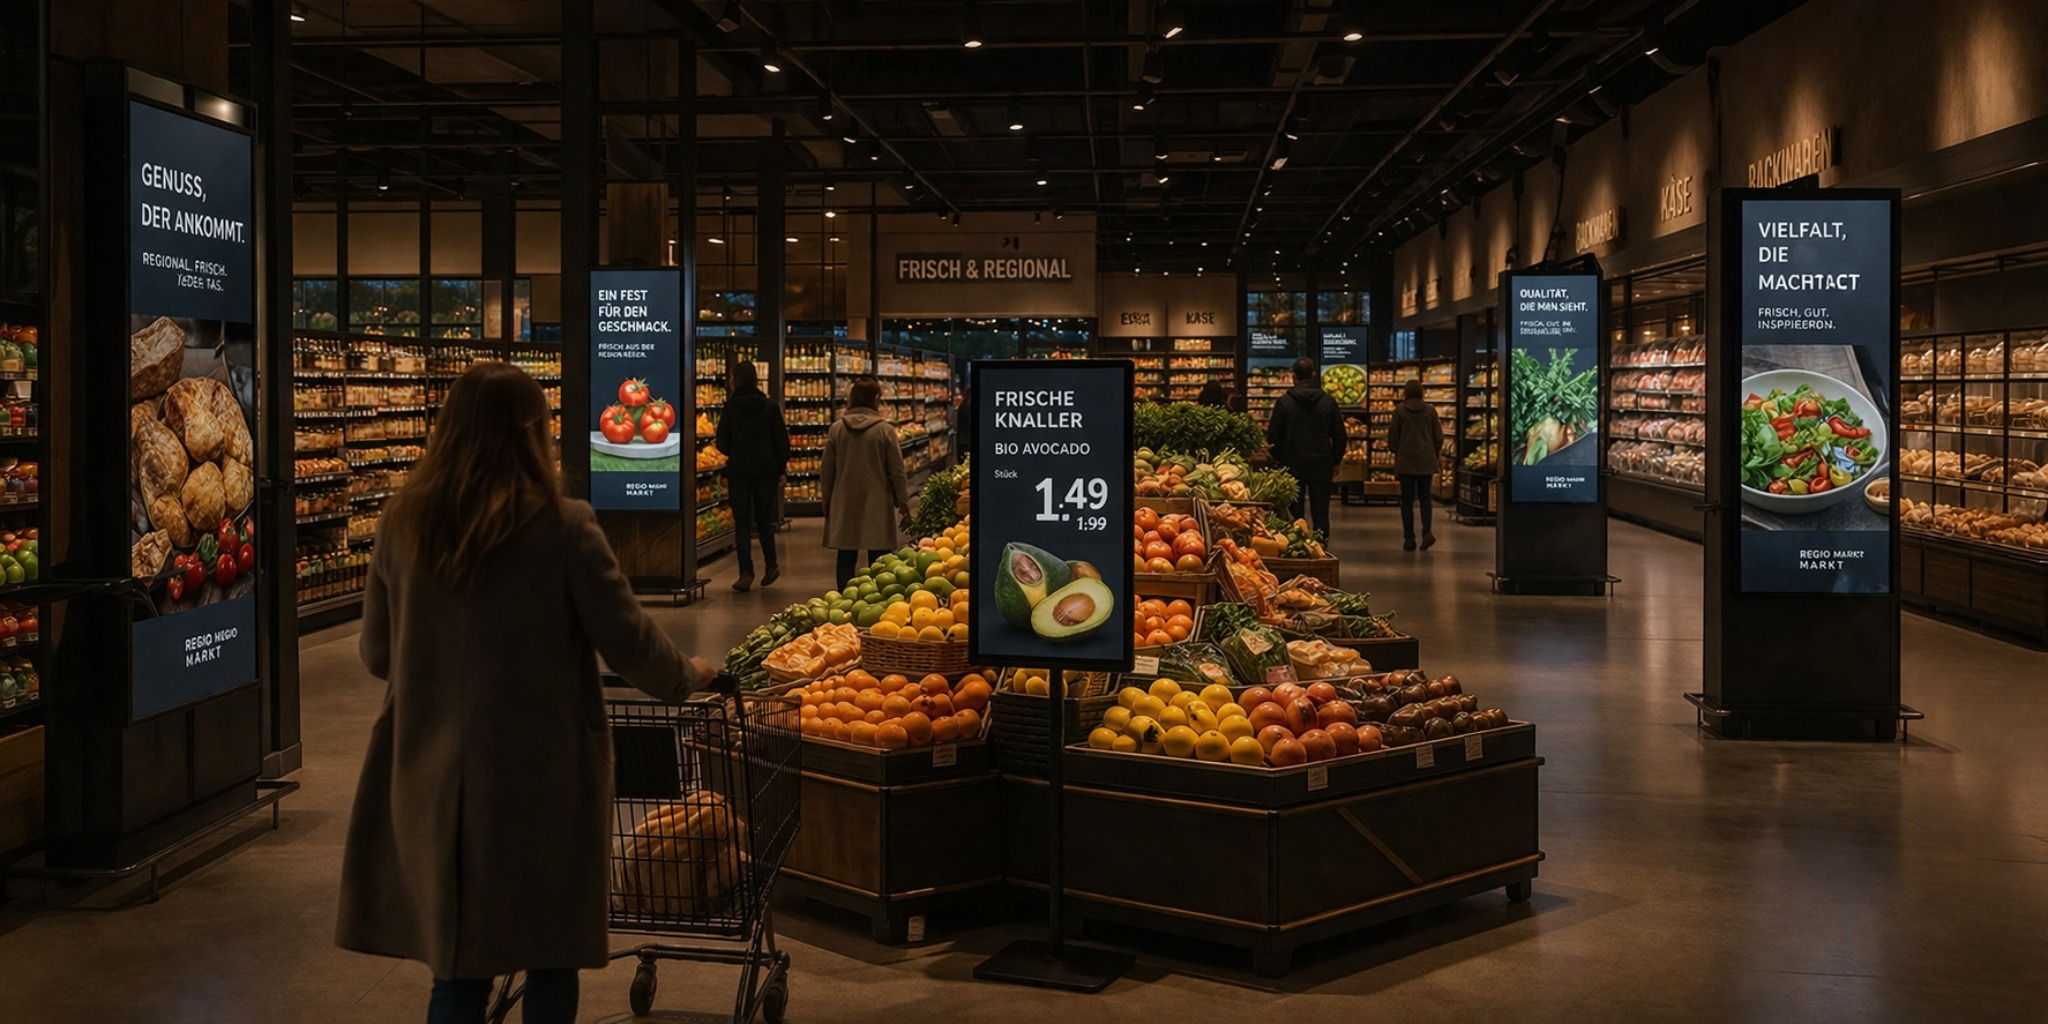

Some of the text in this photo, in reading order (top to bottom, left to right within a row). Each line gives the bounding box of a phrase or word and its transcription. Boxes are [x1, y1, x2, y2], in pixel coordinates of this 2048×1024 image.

[141, 163, 206, 202] GENUSS,
[142, 203, 245, 243] DER ANKOMMT.
[1759, 222, 1846, 240] VIELFALT,
[143, 252, 193, 271] REGIONAL.
[1759, 247, 1788, 262] DIE
[899, 257, 1072, 281] FRISCH & REGIONAL
[599, 290, 648, 300] EIN FEST
[599, 303, 647, 317] FÜR DEN
[1520, 302, 1535, 311] DIE
[1759, 308, 1829, 318] FRISCH, GUT.
[599, 321, 671, 332] GESCHMACK.
[996, 391, 1074, 406] FRISCHE
[996, 412, 1082, 428] KNALLER
[995, 443, 1090, 455] BIO AVOCADO
[995, 470, 1017, 478] Stück
[1800, 550, 1830, 559] REGIO
[1800, 561, 1843, 569] MARKT
[185, 645, 221, 667] MARKT
